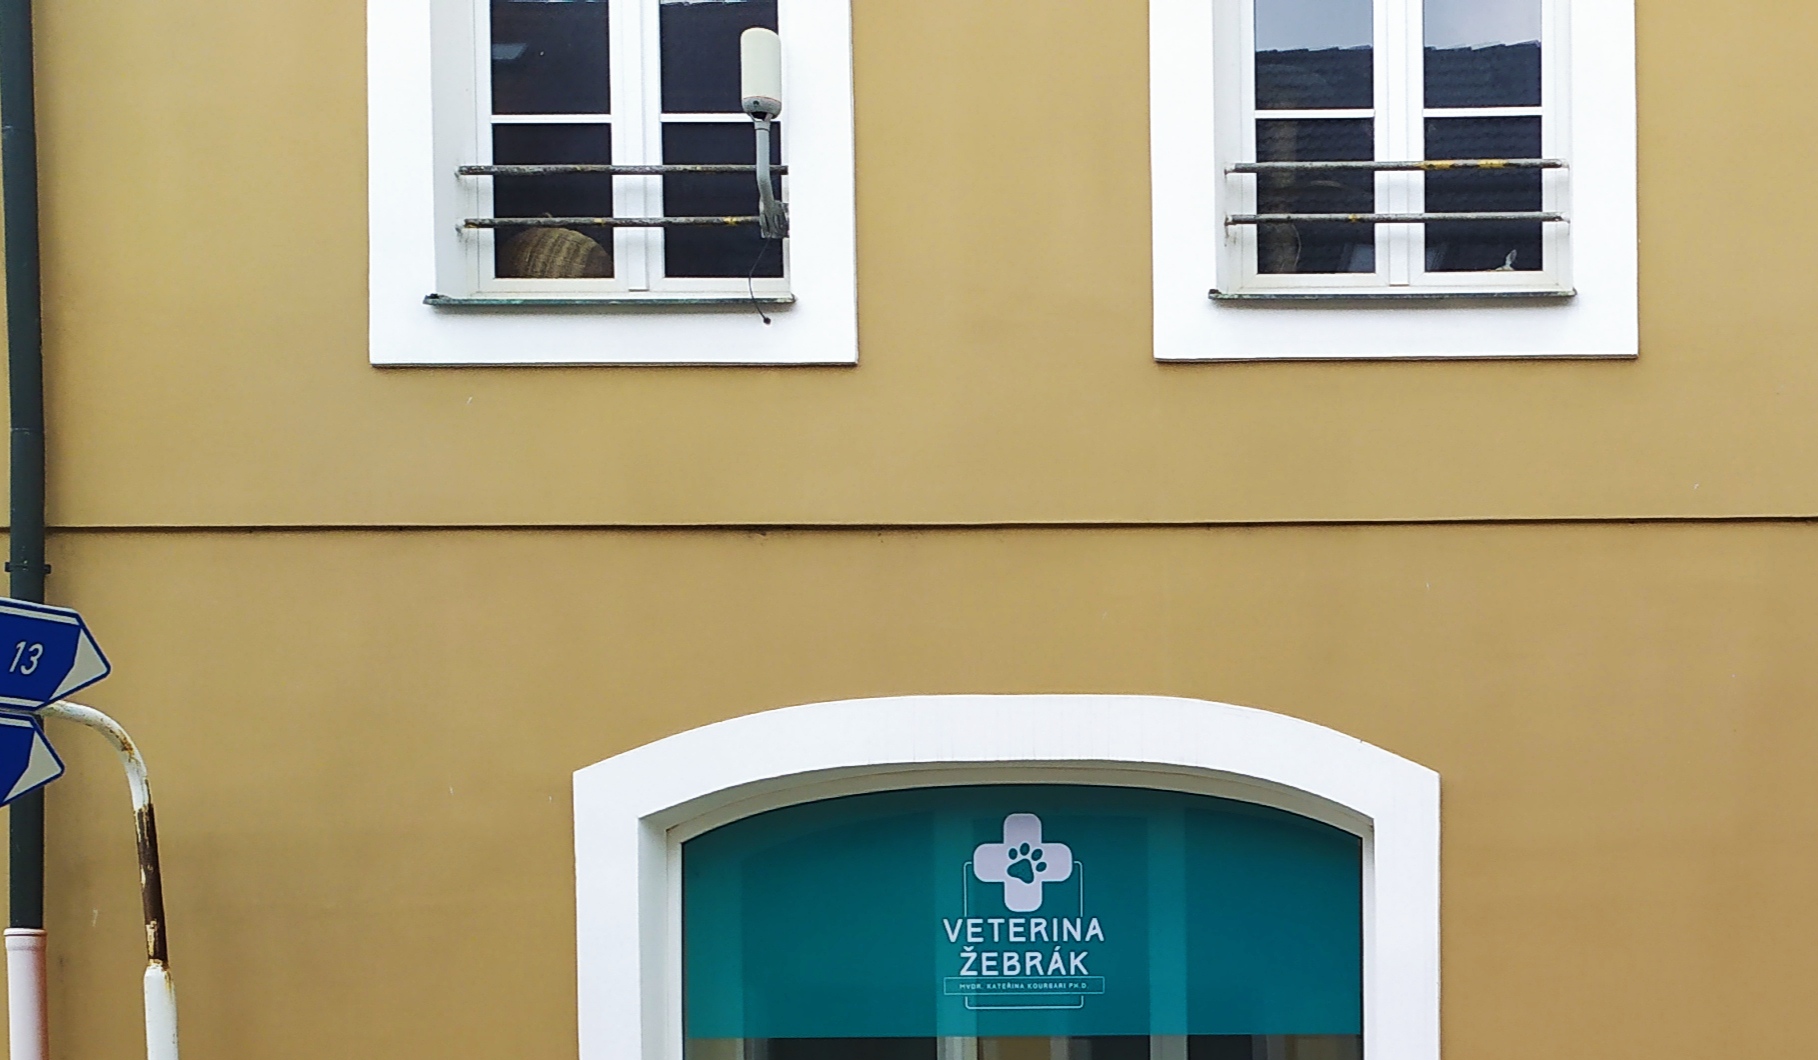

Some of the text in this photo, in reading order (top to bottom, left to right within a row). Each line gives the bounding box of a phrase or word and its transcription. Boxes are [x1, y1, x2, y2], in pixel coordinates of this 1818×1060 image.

[9, 641, 43, 675] 13
[943, 917, 1105, 942] VETERINA
[959, 946, 1089, 976] ŽEBRÁK
